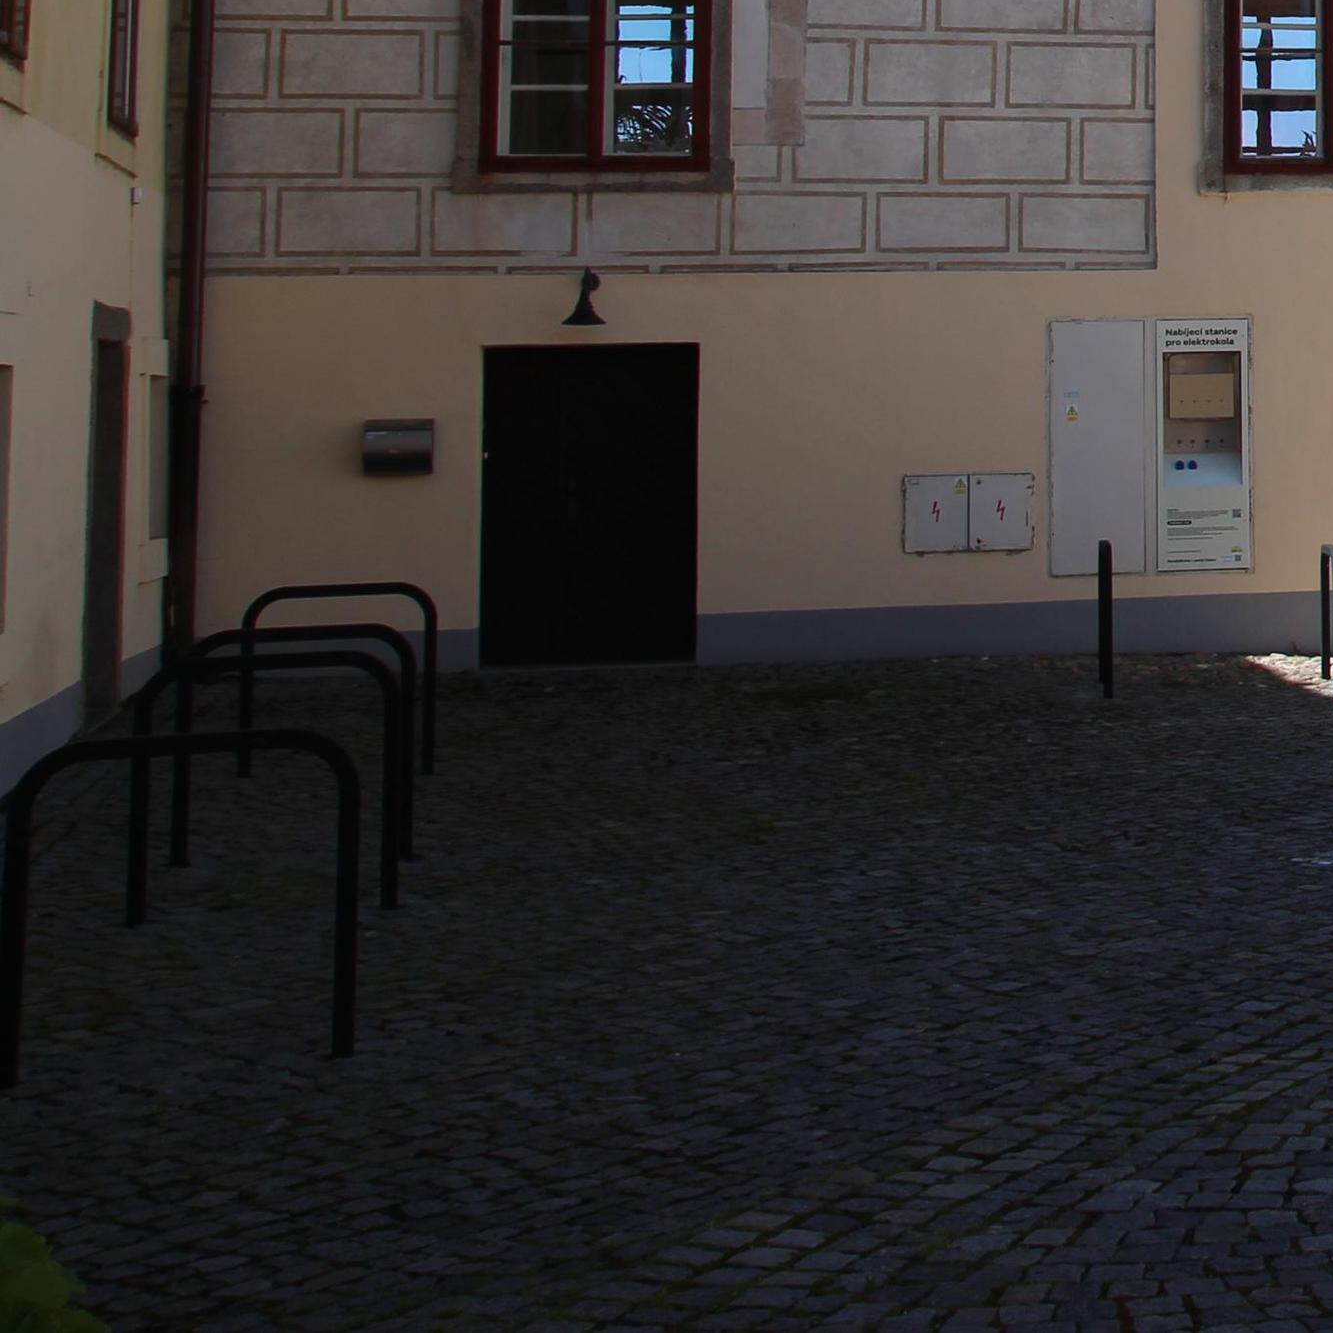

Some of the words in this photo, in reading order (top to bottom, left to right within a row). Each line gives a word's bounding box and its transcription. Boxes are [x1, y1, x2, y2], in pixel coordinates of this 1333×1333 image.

[1165, 328, 1203, 337] Nabíjecí
[1205, 327, 1238, 335] stanice
[1165, 339, 1181, 347] pro
[1183, 337, 1234, 346] elektrokola
